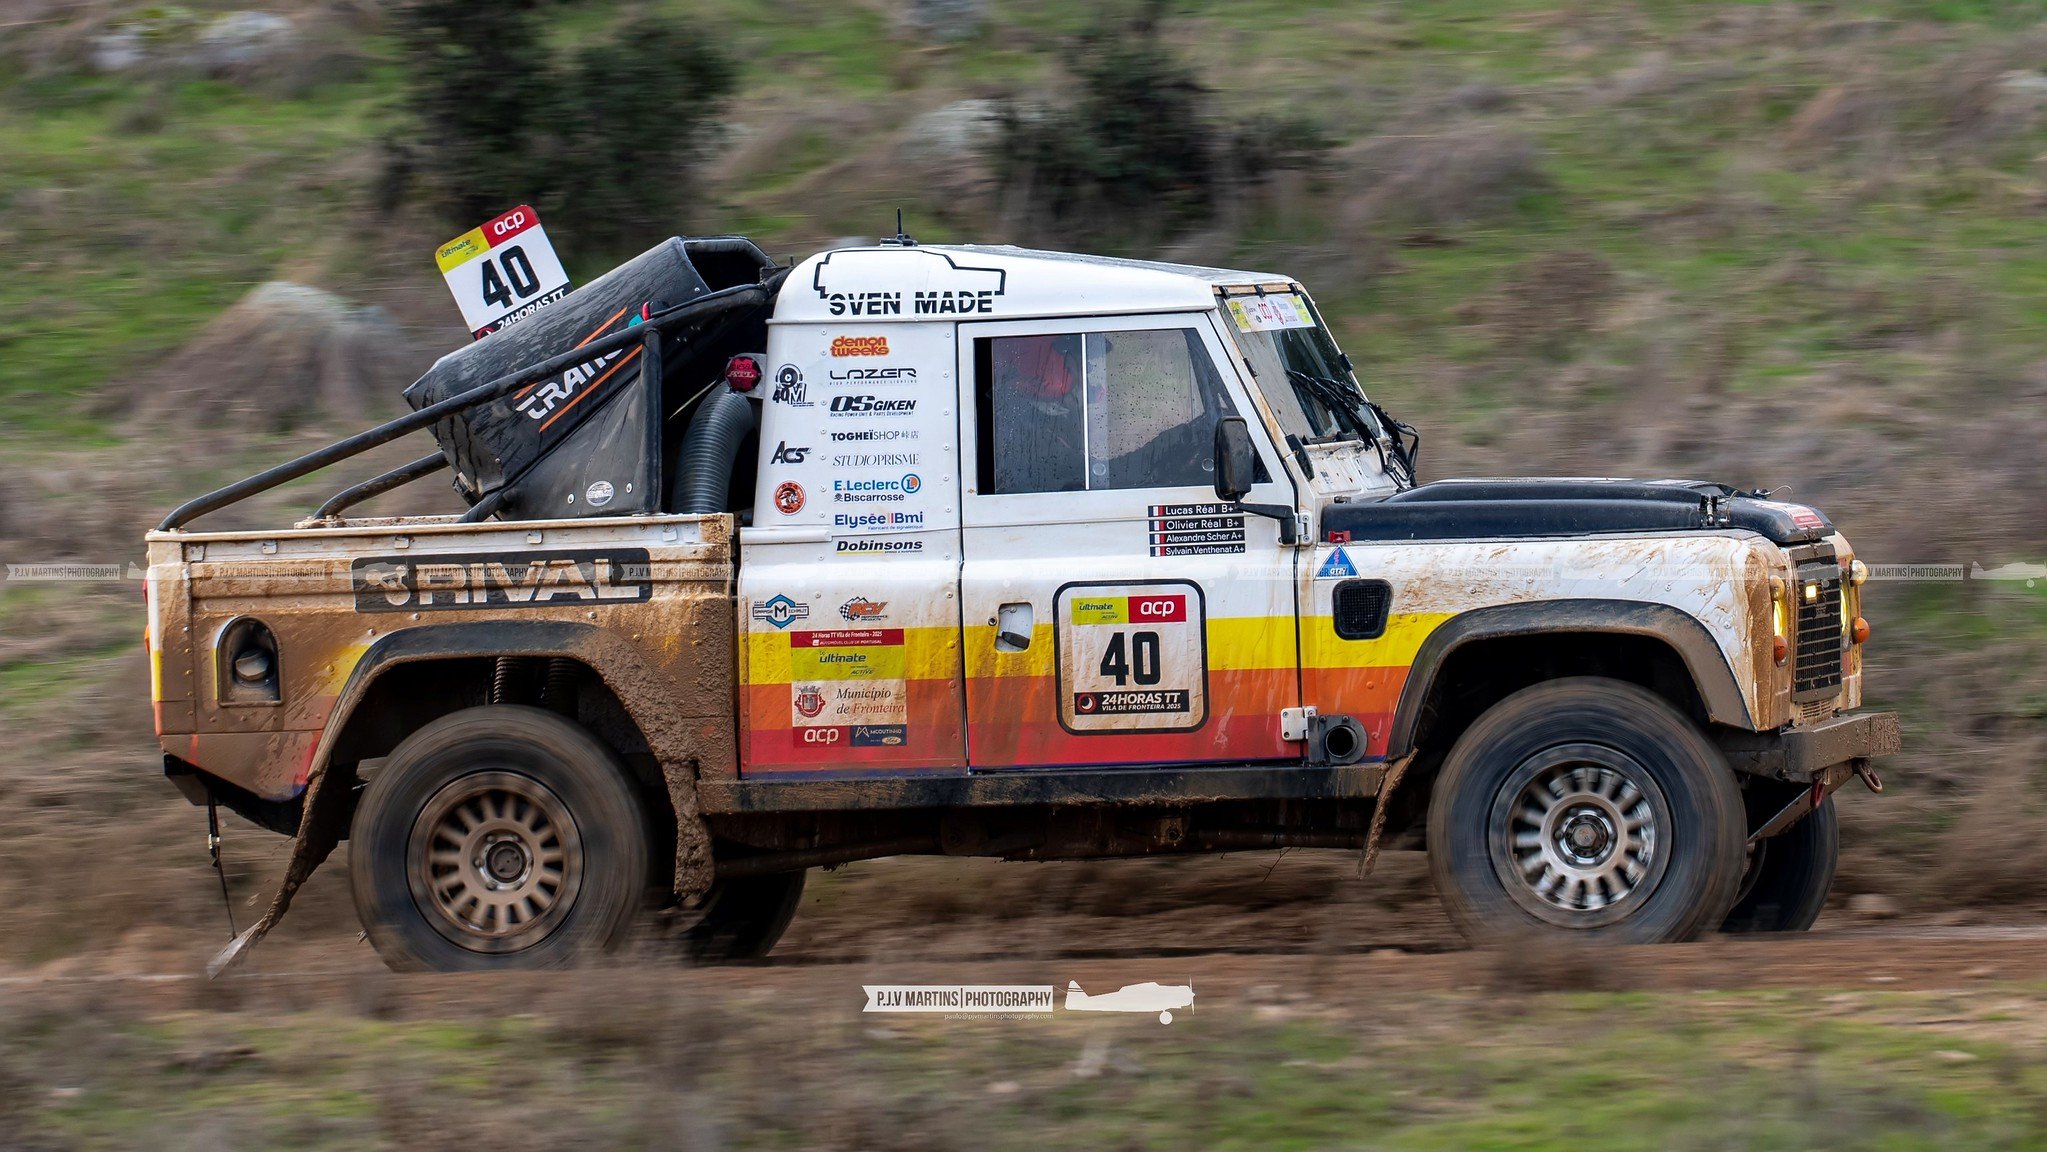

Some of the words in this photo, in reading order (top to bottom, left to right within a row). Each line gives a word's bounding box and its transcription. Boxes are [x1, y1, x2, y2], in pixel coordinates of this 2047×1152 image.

[494, 212, 525, 236] acp
[441, 238, 471, 258] ultimate
[482, 245, 540, 309] 40
[549, 287, 565, 303] TT
[829, 292, 901, 316] SVEN
[915, 291, 993, 314] MADE
[832, 336, 888, 347] demon
[830, 345, 890, 357] tweeks
[830, 368, 917, 380] LAZER
[834, 480, 899, 491] E.Leclerc
[844, 493, 904, 502] Biscarrosse
[1165, 506, 1193, 515] Lucas
[1196, 504, 1216, 514] Réal
[1221, 504, 1233, 513] B+
[834, 513, 886, 528] Elysée
[1166, 520, 1198, 530] Olivier
[1201, 518, 1222, 528] Réal
[1226, 518, 1239, 527] B+
[1166, 534, 1205, 543] Alexandre
[1206, 532, 1229, 541] Scher
[836, 540, 923, 551] Dobinsons
[1166, 547, 1192, 556] Sylvain
[1193, 546, 1233, 555] Venthenat
[1233, 545, 1245, 553] A+
[415, 558, 640, 605] RIVAL
[1079, 602, 1113, 611] ultimate
[1140, 601, 1175, 617] acp
[819, 653, 867, 663] ultimate
[1100, 631, 1161, 686] 40
[836, 687, 892, 699] Município
[1165, 692, 1181, 703] TT
[836, 703, 850, 714] de
[852, 702, 904, 714] Fronteira
[804, 728, 839, 744] acp
